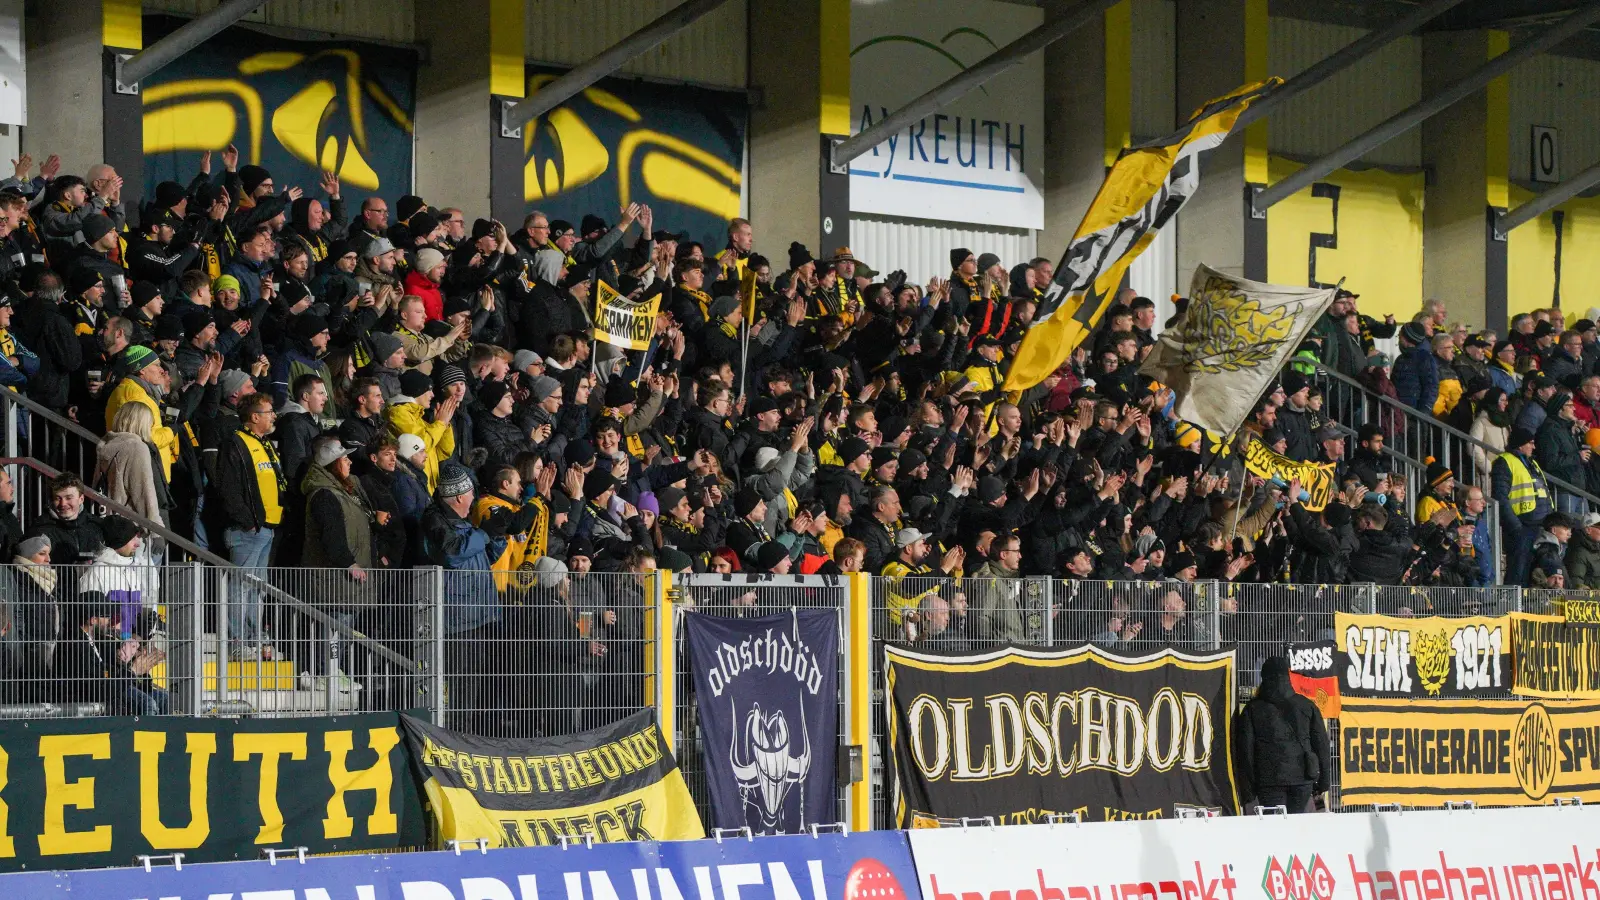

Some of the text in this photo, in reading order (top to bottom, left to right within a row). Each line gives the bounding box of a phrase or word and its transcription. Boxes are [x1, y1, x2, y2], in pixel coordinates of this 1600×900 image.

[1346, 624, 1502, 693] SZENE 1921
[1343, 727, 1511, 774] GEGENGERADE
[0, 726, 400, 858] EUTH
